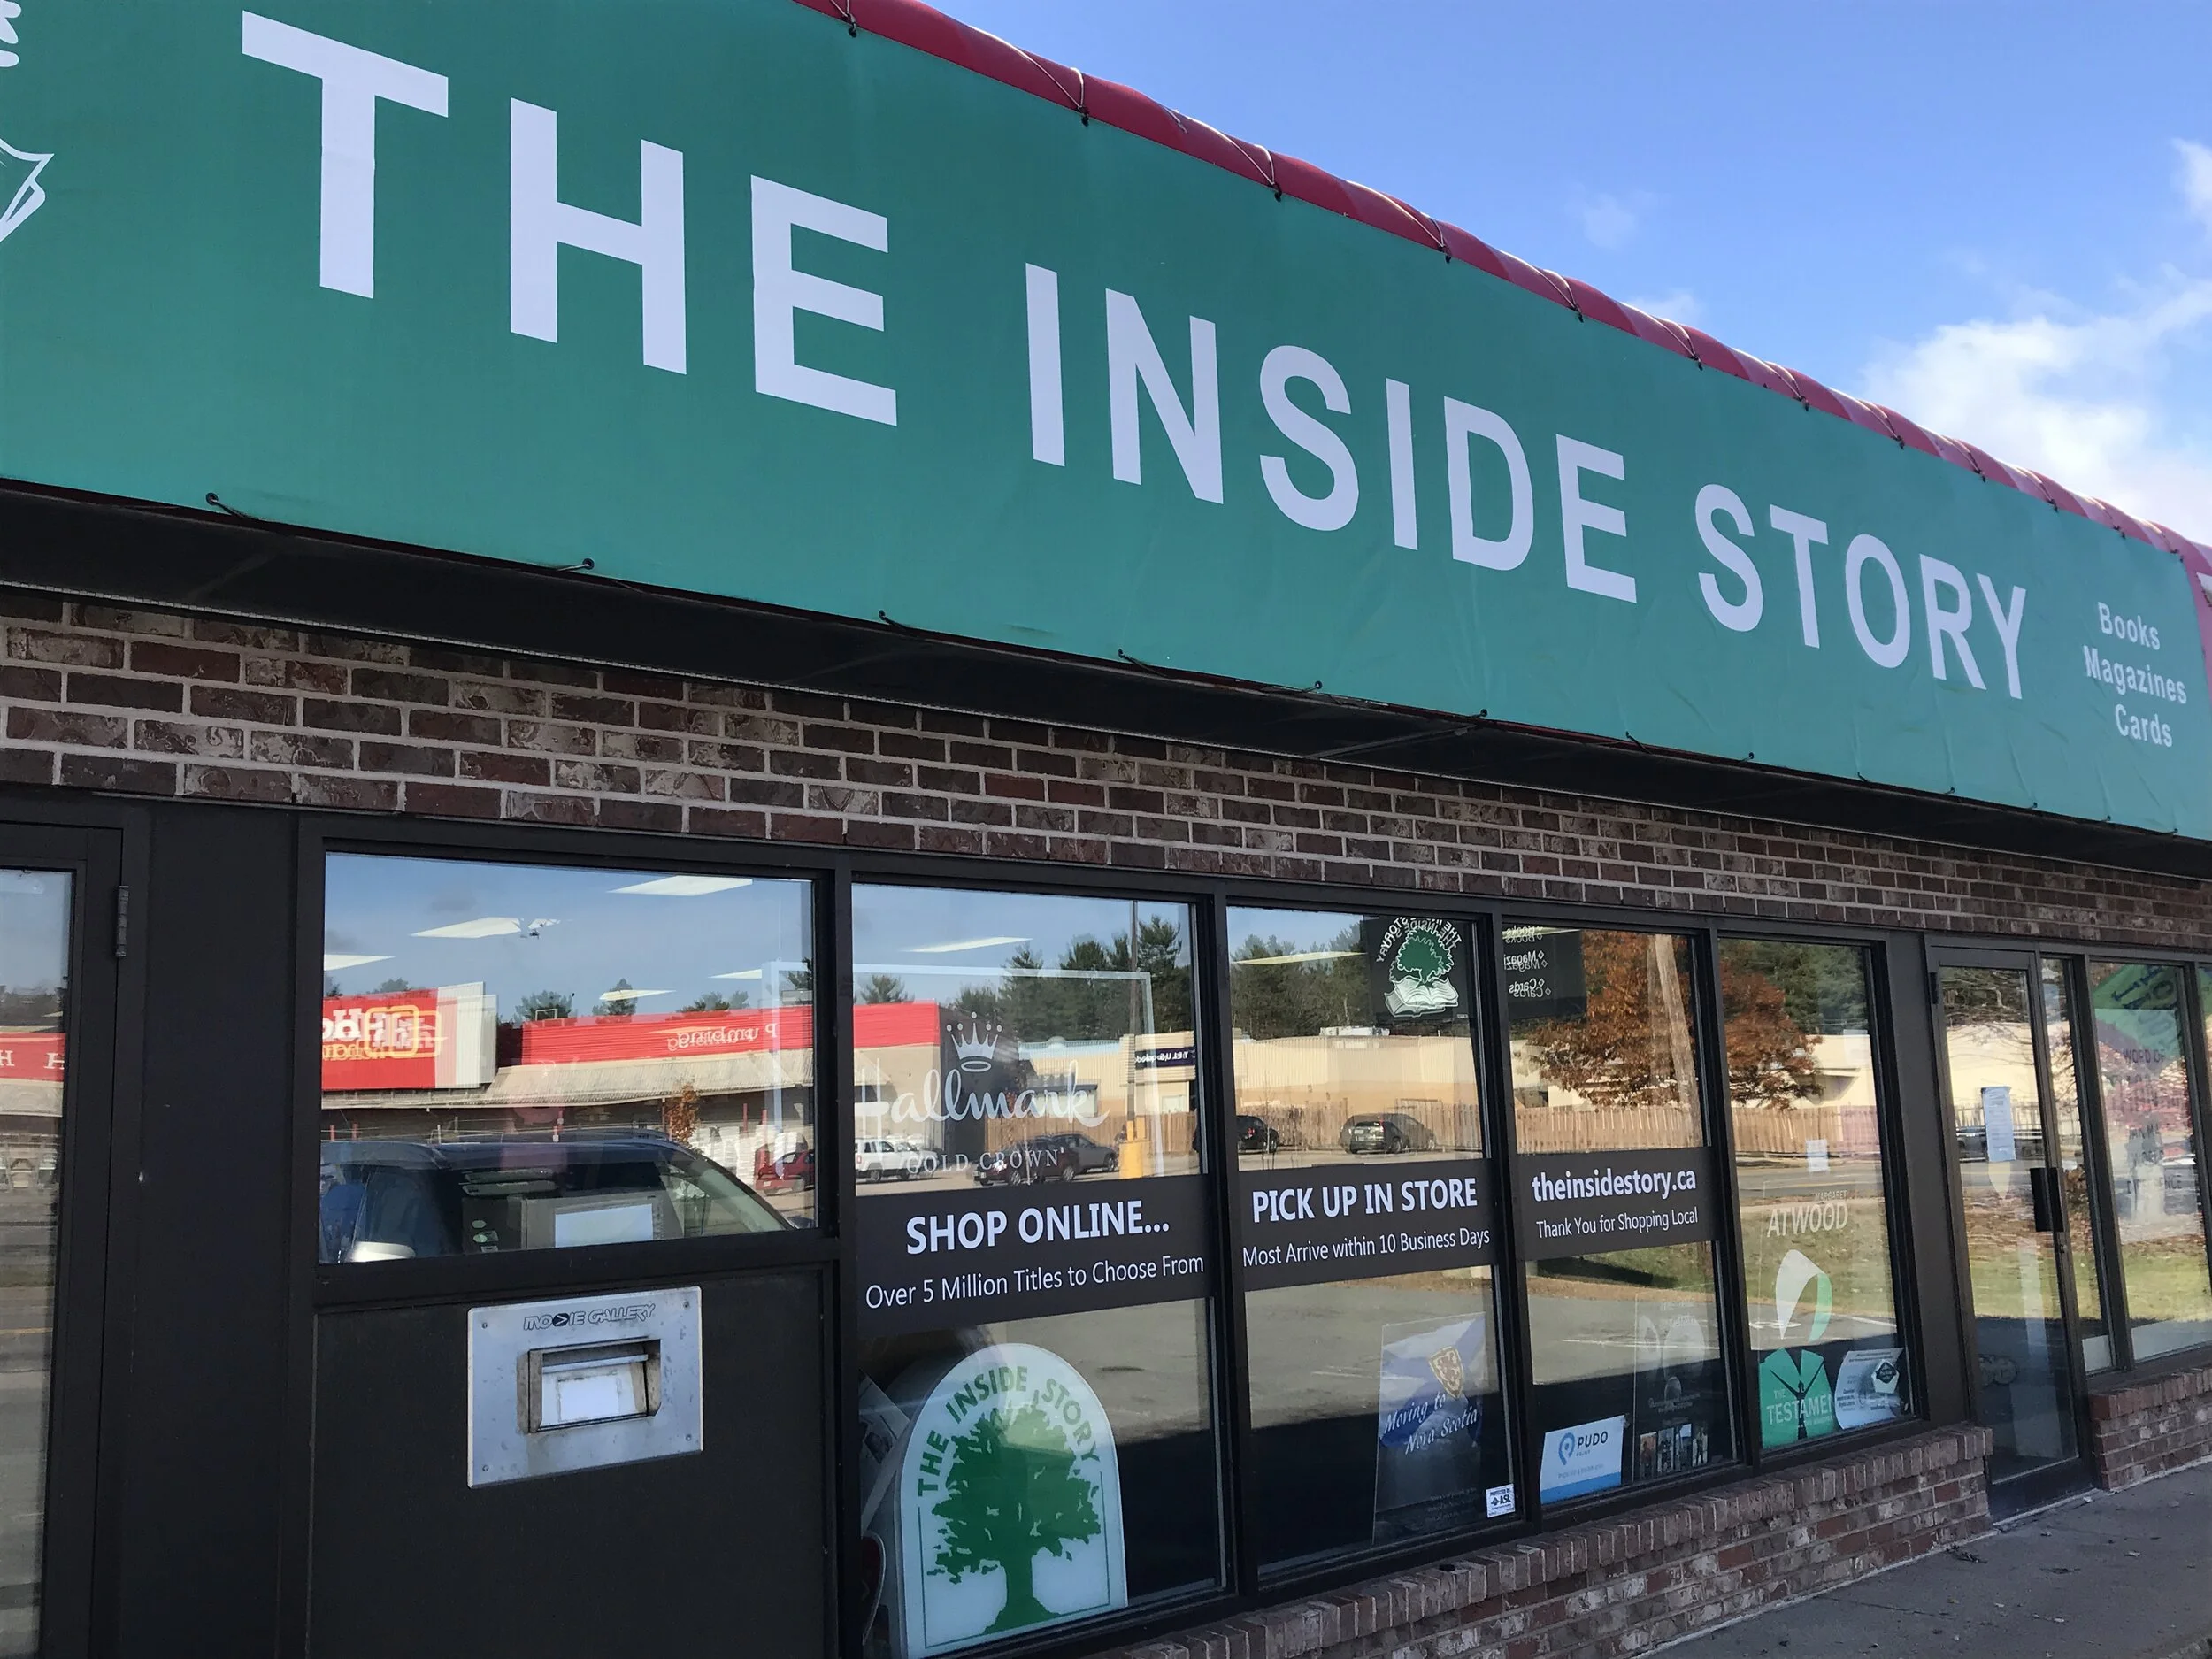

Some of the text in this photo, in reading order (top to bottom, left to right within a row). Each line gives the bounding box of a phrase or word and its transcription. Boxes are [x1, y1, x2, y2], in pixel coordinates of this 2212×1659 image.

[242, 11, 2026, 699] THE INSIDE STORY
[2097, 602, 2160, 650] Books
[2082, 645, 2187, 705] Magazines
[2115, 703, 2172, 748] Cards
[855, 1058, 1110, 1143] Hallmark
[907, 1152, 970, 1174] GOLD
[1532, 1168, 1696, 1202] theinsidestory.ca
[1252, 1178, 1478, 1223] PICK UP IN STORE
[1536, 1206, 1698, 1239] Thank You for Shopping Local
[1767, 1202, 1849, 1237] ATWOOD
[906, 1200, 1170, 1255] SHOP ONLINE...
[1242, 1227, 1491, 1267] Most Arrive within 10 Business Days
[865, 1255, 1204, 1309] Over 5 Million Titles to Choose From
[588, 1303, 656, 1325] GALLERY
[918, 1366, 1101, 1497] THE INSIDE STORY
[1384, 1391, 1446, 1434] Moving to
[1405, 1406, 1478, 1455] Nova Scotia
[1577, 1431, 1609, 1449] PUDO
[1499, 1494, 1511, 1505] ASL
